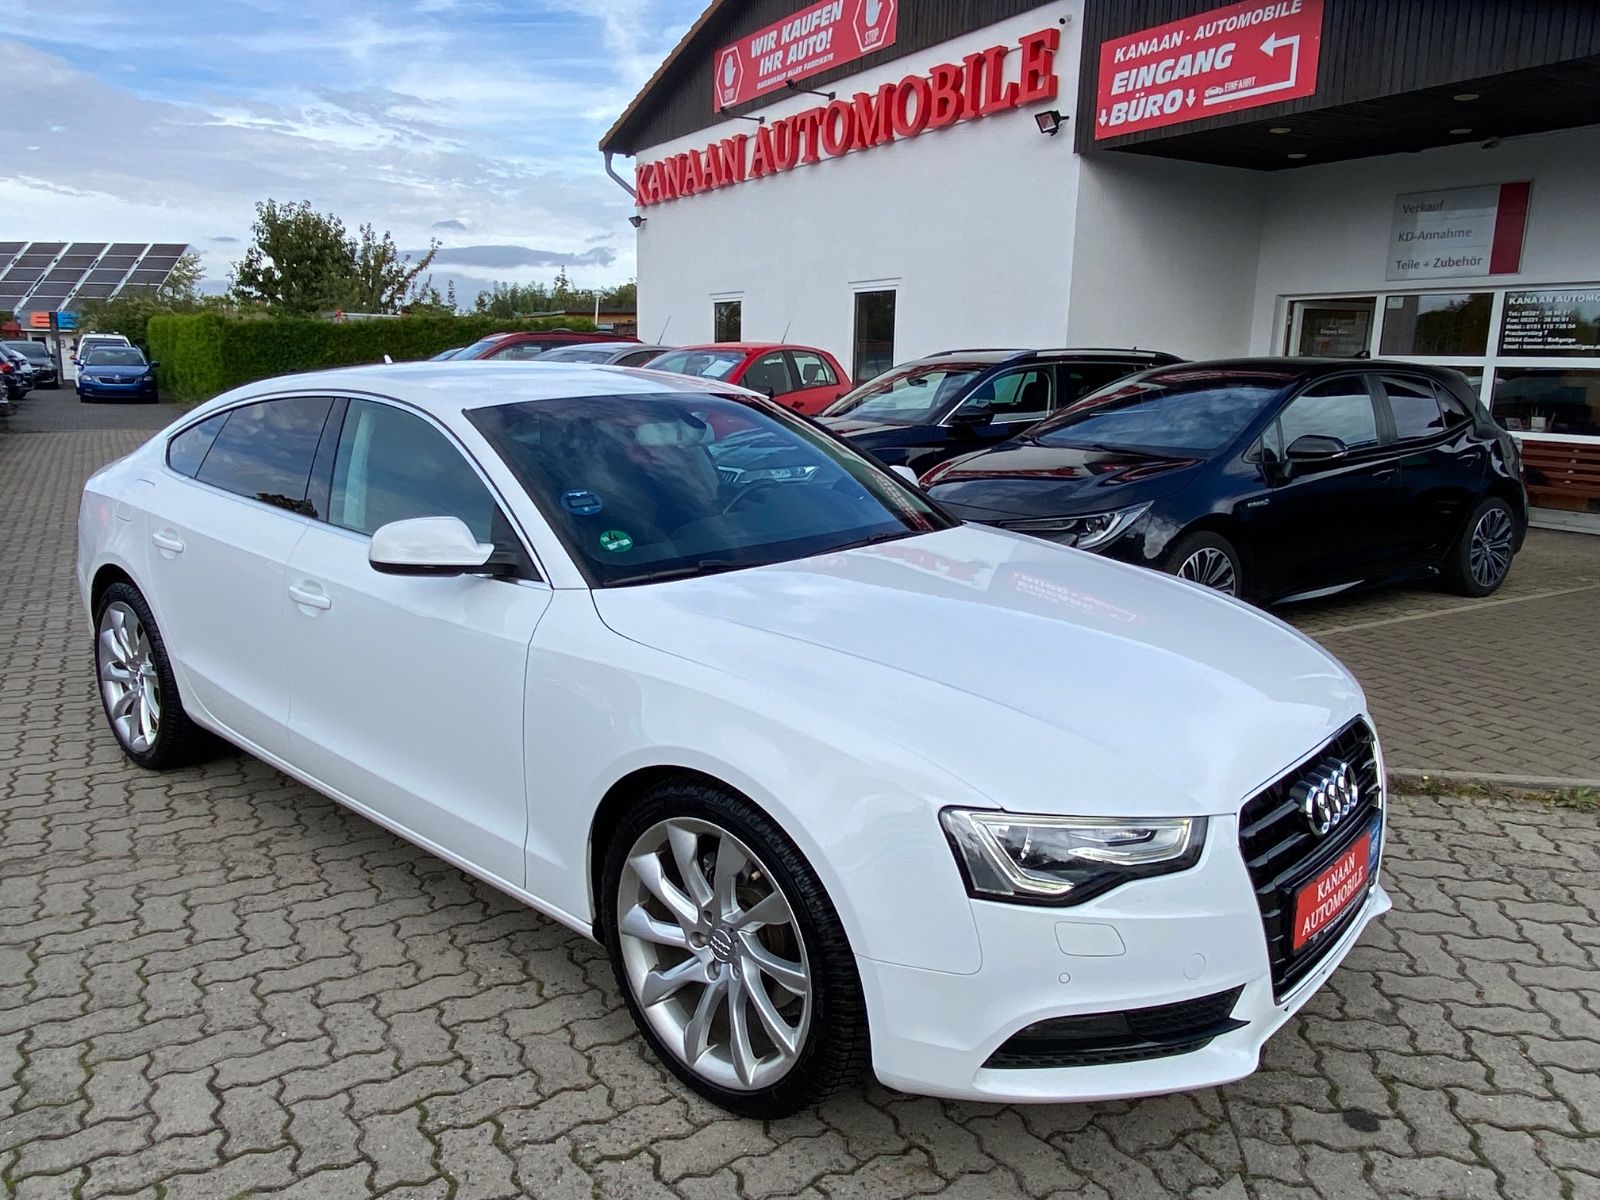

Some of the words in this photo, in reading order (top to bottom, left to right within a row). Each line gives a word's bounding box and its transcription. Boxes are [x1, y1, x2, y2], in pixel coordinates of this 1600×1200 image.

[751, 30, 777, 58] WIR
[781, 0, 844, 45] KAUFEN
[864, 27, 879, 45] STOP
[1114, 30, 1184, 64] KANAAN
[1194, 0, 1301, 41] AUTOMOBILE
[758, 53, 783, 77] IHR
[786, 27, 833, 65] AUTO!
[1111, 42, 1236, 96] EINGANG
[1224, 76, 1256, 93] EINFAHRT
[635, 133, 748, 207] KANAAN
[749, 28, 1060, 178] AUTOMOBILE
[1108, 88, 1184, 127] BÜRO
[1403, 200, 1445, 214] Verkauf
[1398, 229, 1472, 242] KD-Annahme
[1395, 260, 1420, 270] Teile
[1432, 256, 1483, 268] Zubehör
[1508, 296, 1554, 305] KANAAN
[1317, 852, 1356, 902] KANAAN
[1301, 865, 1364, 937] AUTOMOBILE
